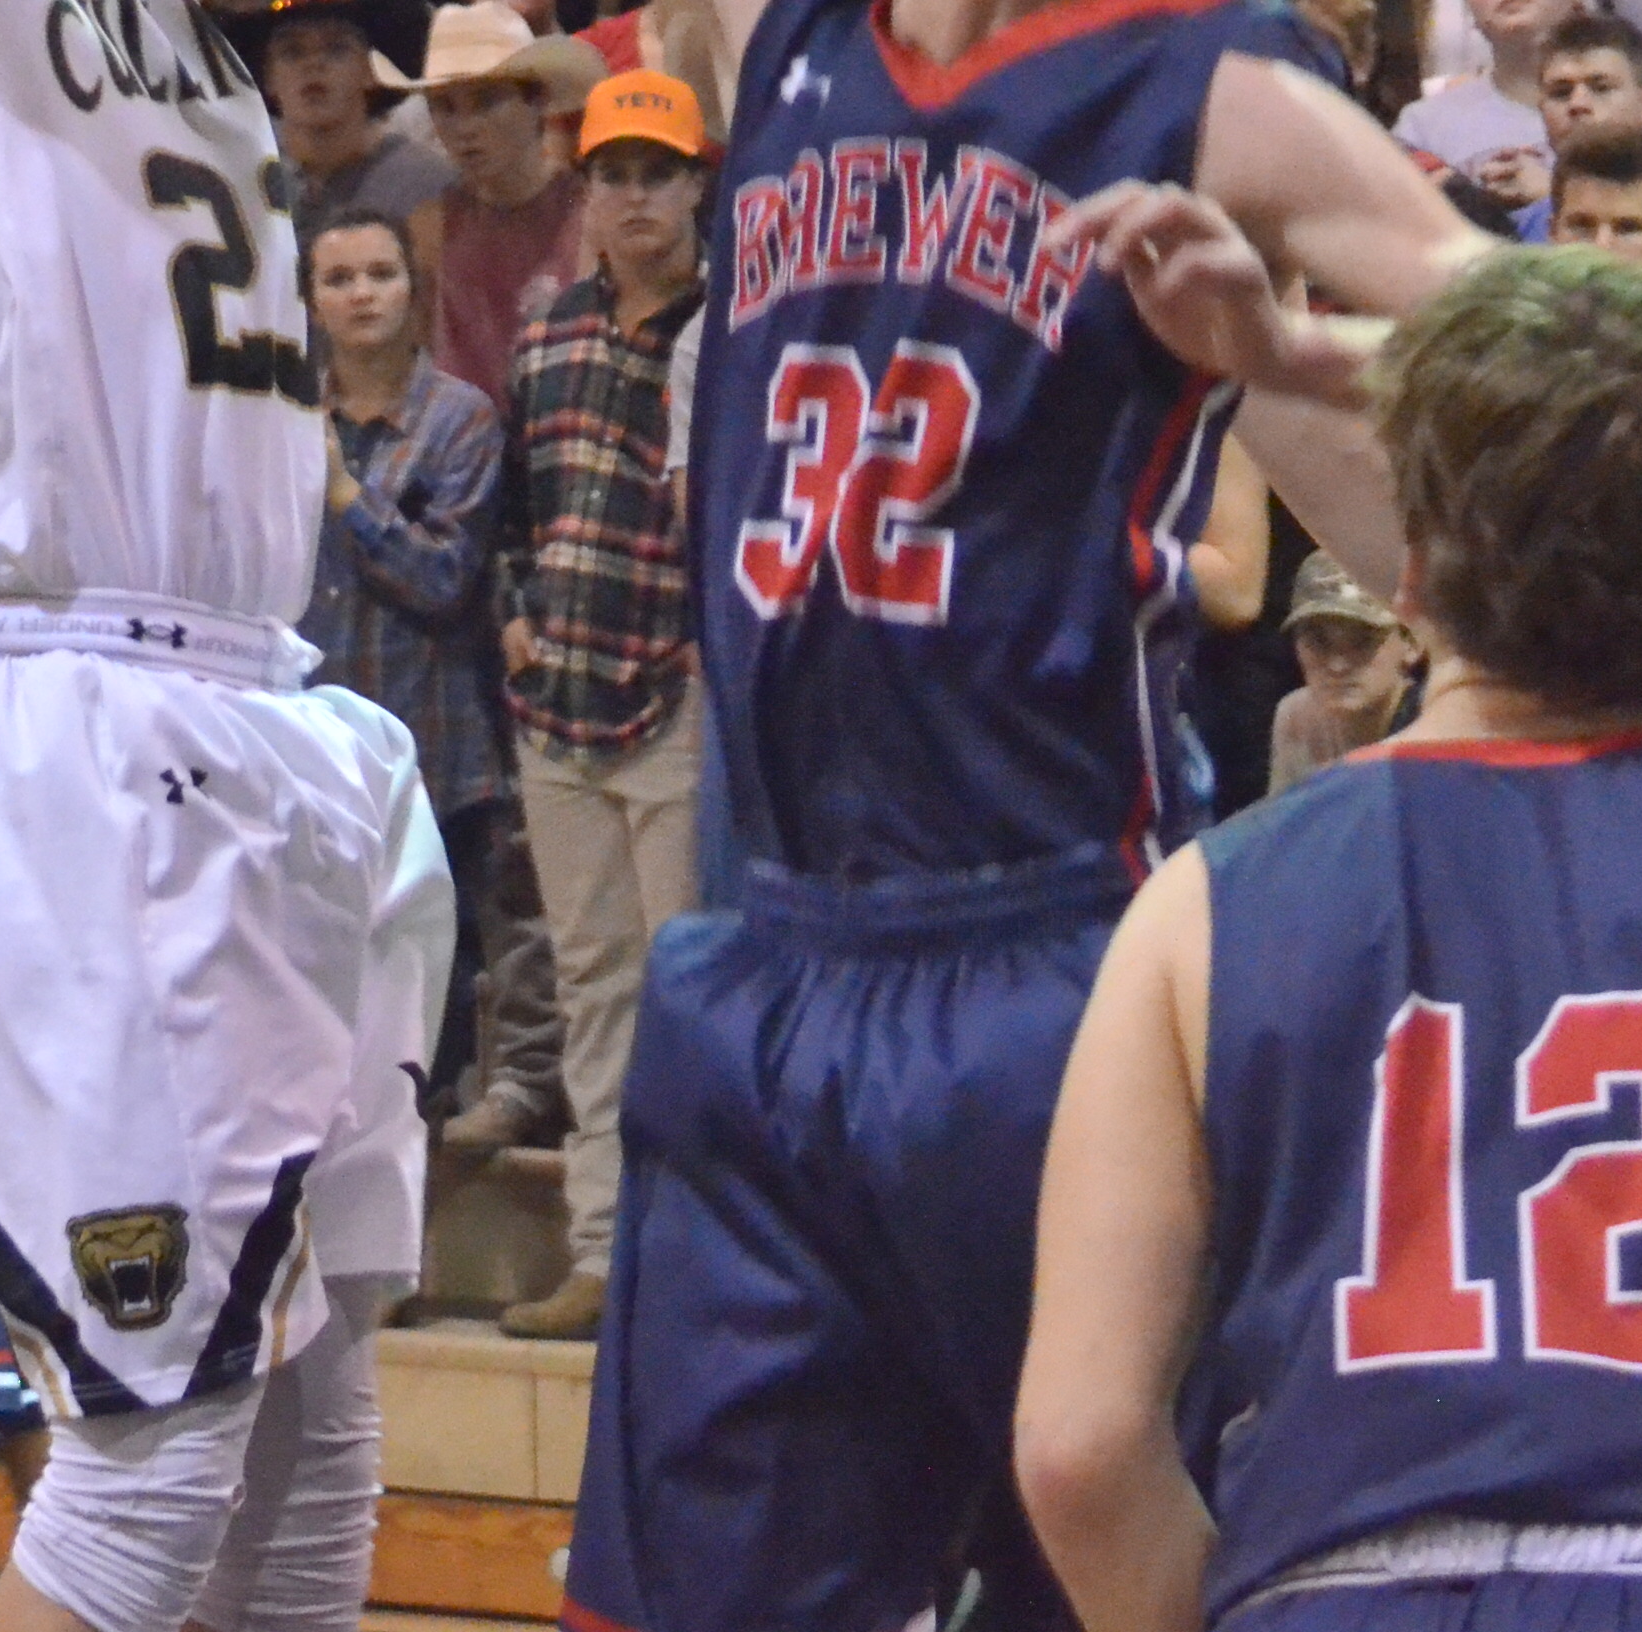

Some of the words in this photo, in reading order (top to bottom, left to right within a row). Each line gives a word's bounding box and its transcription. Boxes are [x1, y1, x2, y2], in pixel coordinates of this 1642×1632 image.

[614, 91, 674, 113] YETI
[729, 135, 1095, 353] BREWER
[734, 337, 981, 626] 32
